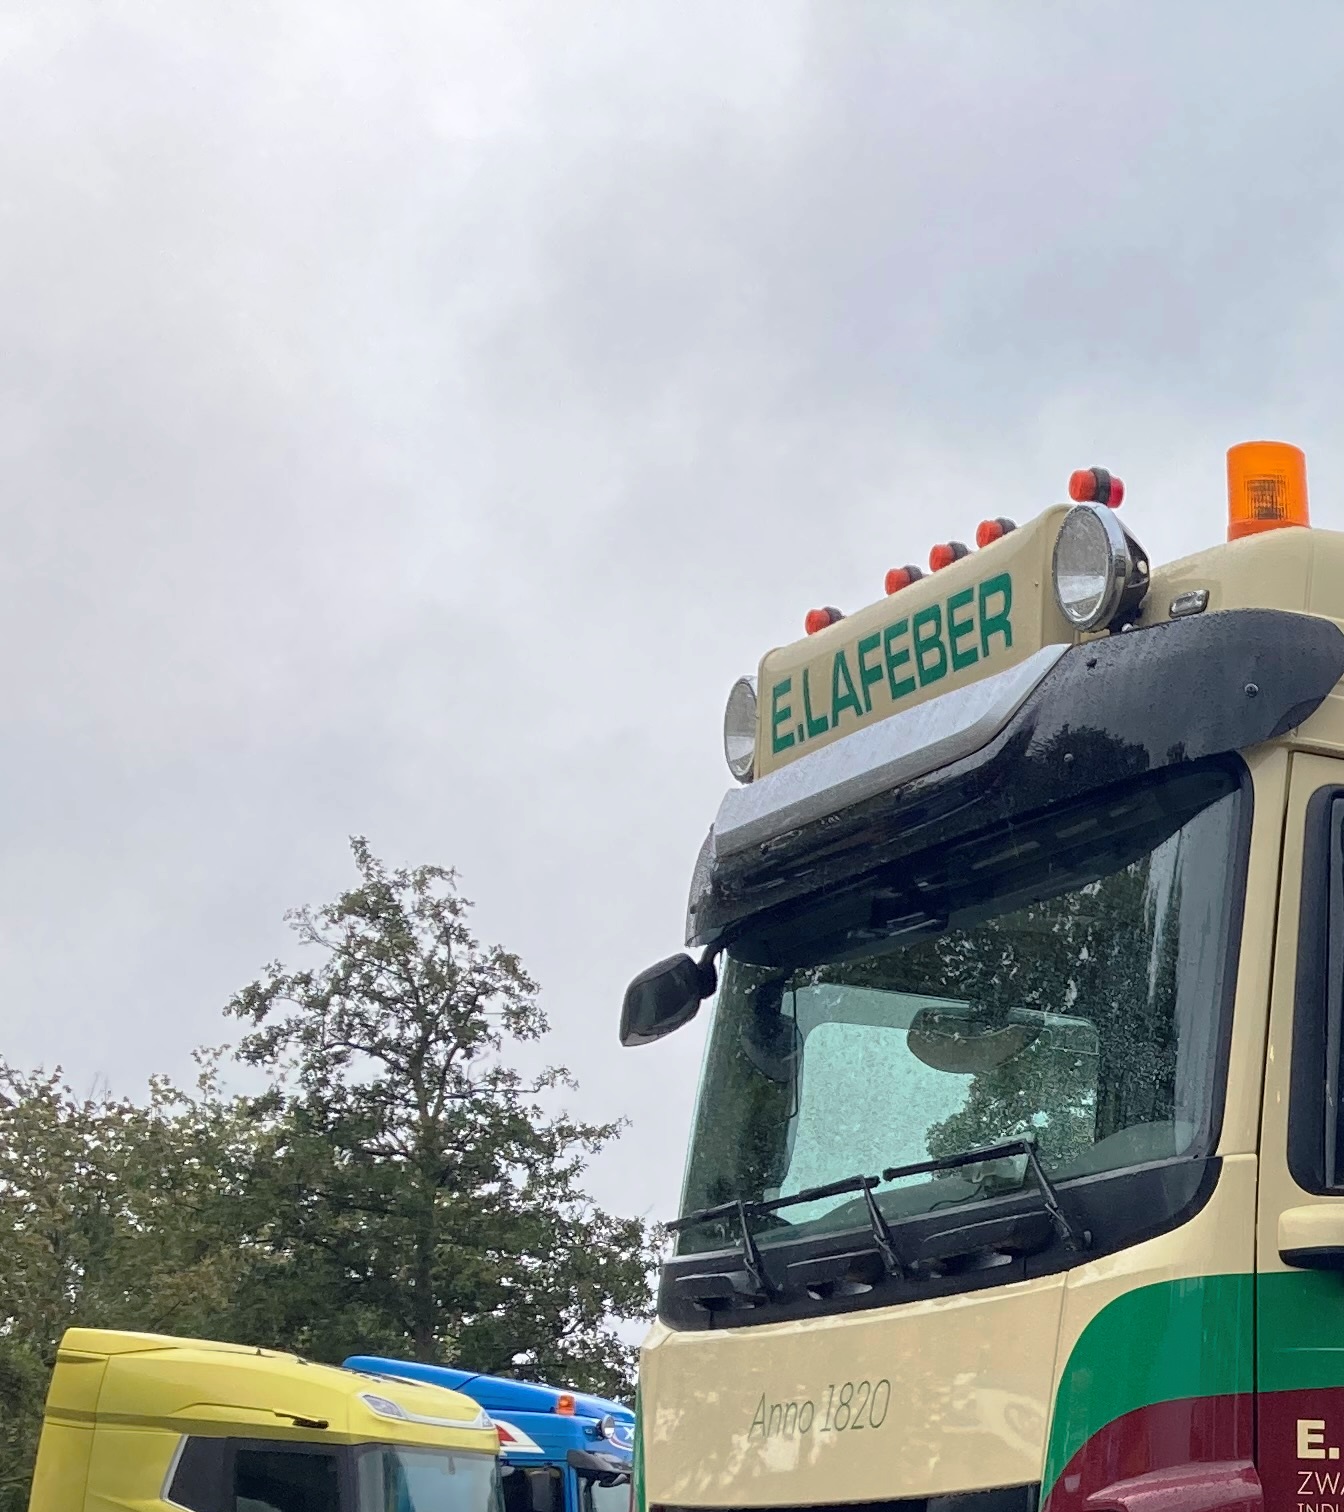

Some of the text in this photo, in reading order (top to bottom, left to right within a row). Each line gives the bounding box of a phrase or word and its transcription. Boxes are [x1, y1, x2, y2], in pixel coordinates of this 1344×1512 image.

[771, 572, 1013, 755] E.LAFEBER
[747, 1379, 892, 1439] Anno 1820
[1296, 1419, 1340, 1460] E.
